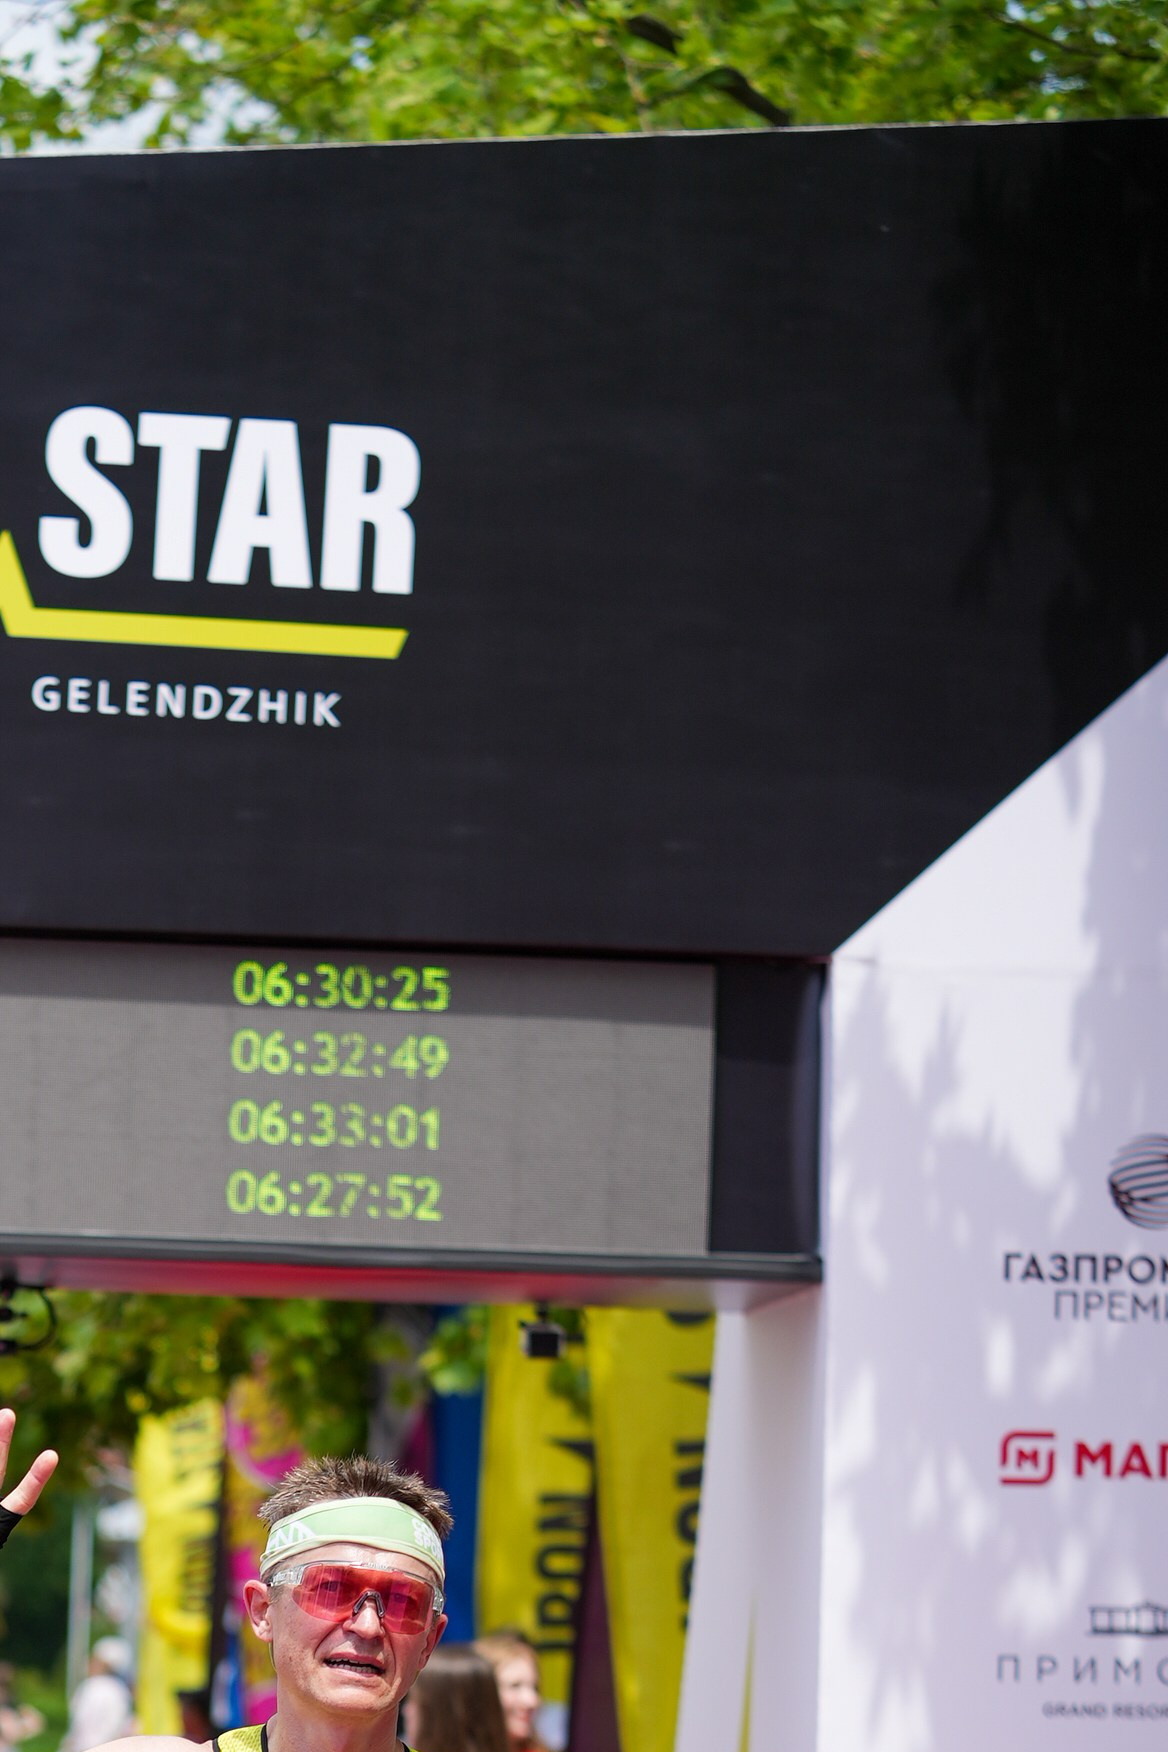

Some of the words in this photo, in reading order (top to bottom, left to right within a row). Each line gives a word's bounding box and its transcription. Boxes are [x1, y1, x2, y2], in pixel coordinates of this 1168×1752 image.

[38, 405, 422, 595] STAR
[32, 676, 341, 727] GELENDZHIK
[233, 960, 451, 1012] 06:30:25
[230, 1028, 450, 1078] 06:32:49
[229, 1100, 440, 1149] 06:33:01
[227, 1169, 443, 1221] 06:27:52
[1054, 1289, 1168, 1322] ПРЕМ
